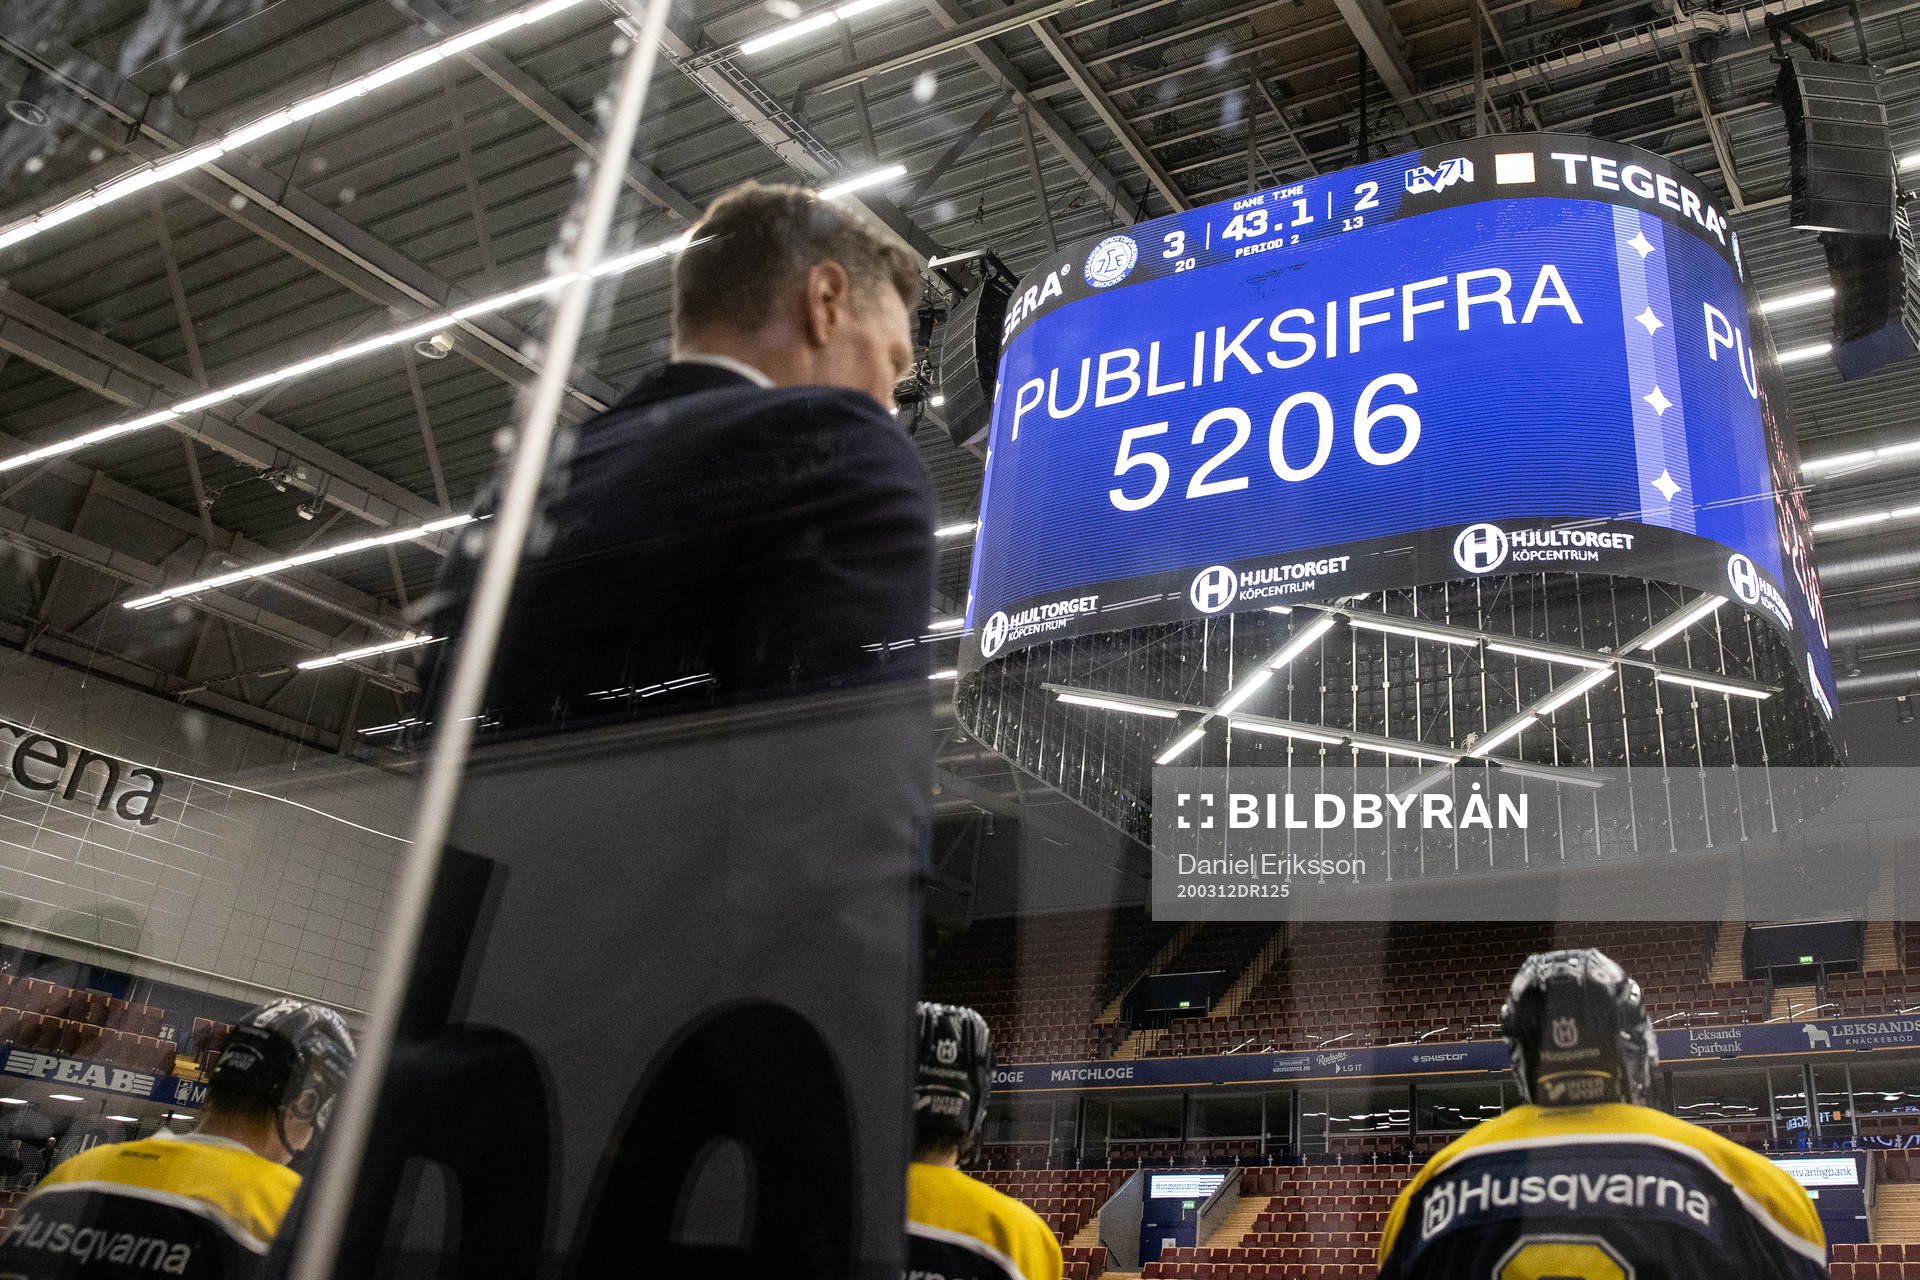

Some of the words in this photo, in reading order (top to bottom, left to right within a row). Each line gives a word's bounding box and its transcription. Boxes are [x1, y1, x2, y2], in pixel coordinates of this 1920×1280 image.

[1233, 194, 1264, 211] GAME
[1272, 185, 1304, 201] TIME
[1353, 181, 1379, 212] 2
[1222, 197, 1314, 242] 43.1
[1343, 216, 1364, 231] 13
[1162, 230, 1186, 259] 3
[1235, 237, 1283, 258] PERIOD
[1290, 234, 1300, 245] 2
[1174, 257, 1196, 273] 20
[1012, 264, 1584, 442] PUBLIKSIFFRA
[1109, 372, 1421, 511] 5206
[1512, 530, 1635, 550] HJULTORGET
[1240, 556, 1350, 587] HJULTORGET
[1009, 595, 1099, 628] HJULTORGET
[1689, 1028, 1742, 1041] Leksands
[1690, 1041, 1742, 1056] Sparbank
[28, 1053, 136, 1093] PEAB
[1051, 1067, 1134, 1082] MATCHLOGE
[1458, 1173, 1711, 1226] Husqvarna
[9, 1211, 192, 1275] Husqvarna
